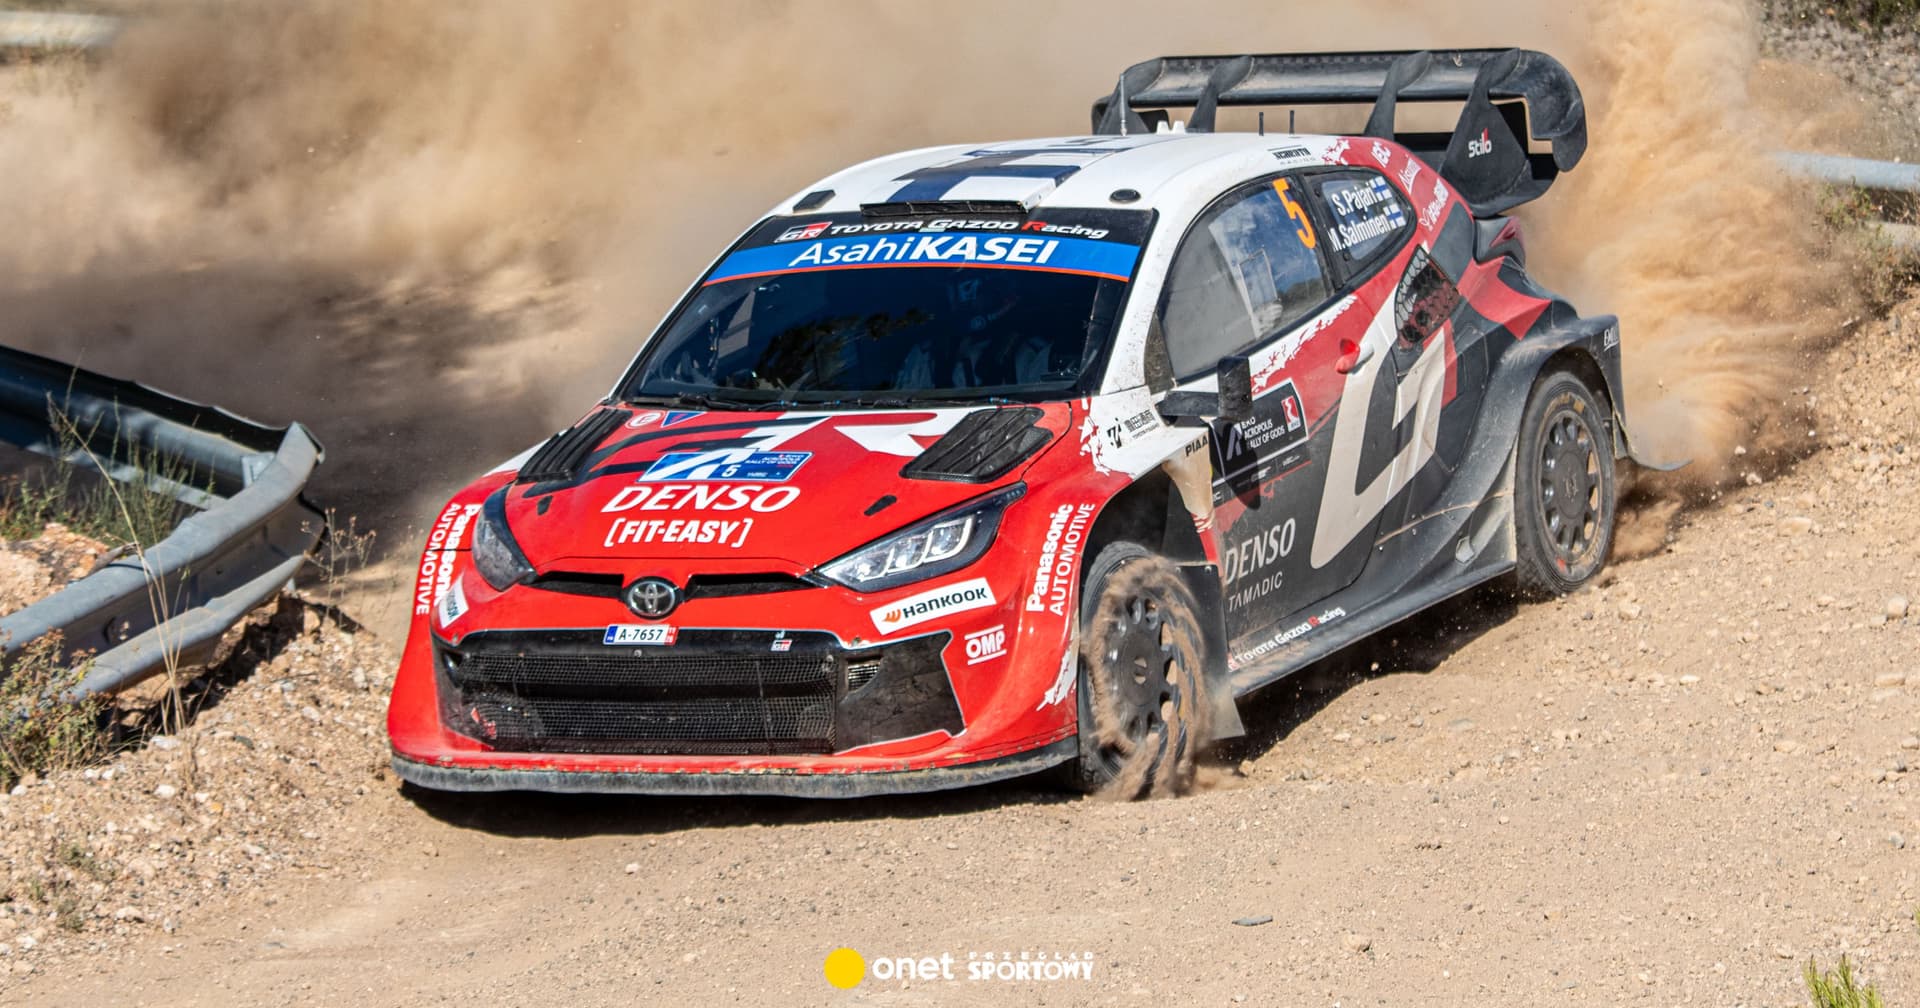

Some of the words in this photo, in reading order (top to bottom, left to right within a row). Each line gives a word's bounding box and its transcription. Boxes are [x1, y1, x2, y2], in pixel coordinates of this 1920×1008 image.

[1468, 128, 1492, 158] Stilo
[1272, 178, 1317, 250] 5
[1331, 182, 1379, 217] S.Pajari
[830, 221, 924, 235] TOYOTA
[927, 219, 1019, 230] GAZOO
[1020, 220, 1110, 239] Racing
[1327, 213, 1392, 252] M.Salminen
[1244, 419, 1273, 440] ACROPOLIS
[1261, 434, 1270, 443] OF
[1269, 424, 1286, 440] GODS
[1185, 436, 1208, 457] PIAA
[722, 464, 740, 478] 5
[600, 484, 801, 513] DENSO
[415, 502, 461, 616] AUTOMOTIVE
[1026, 503, 1074, 612] Panasonic
[1050, 503, 1096, 616] AUTOMOTIVE
[1225, 517, 1296, 585] DENSO
[1228, 571, 1283, 612] TAMADIC
[617, 628, 664, 641] A-7657
[966, 630, 1007, 659] OMP
[1235, 639, 1279, 665] TOYOTA
[1274, 622, 1312, 646] GAZOO
[1308, 606, 1346, 628] Racing
